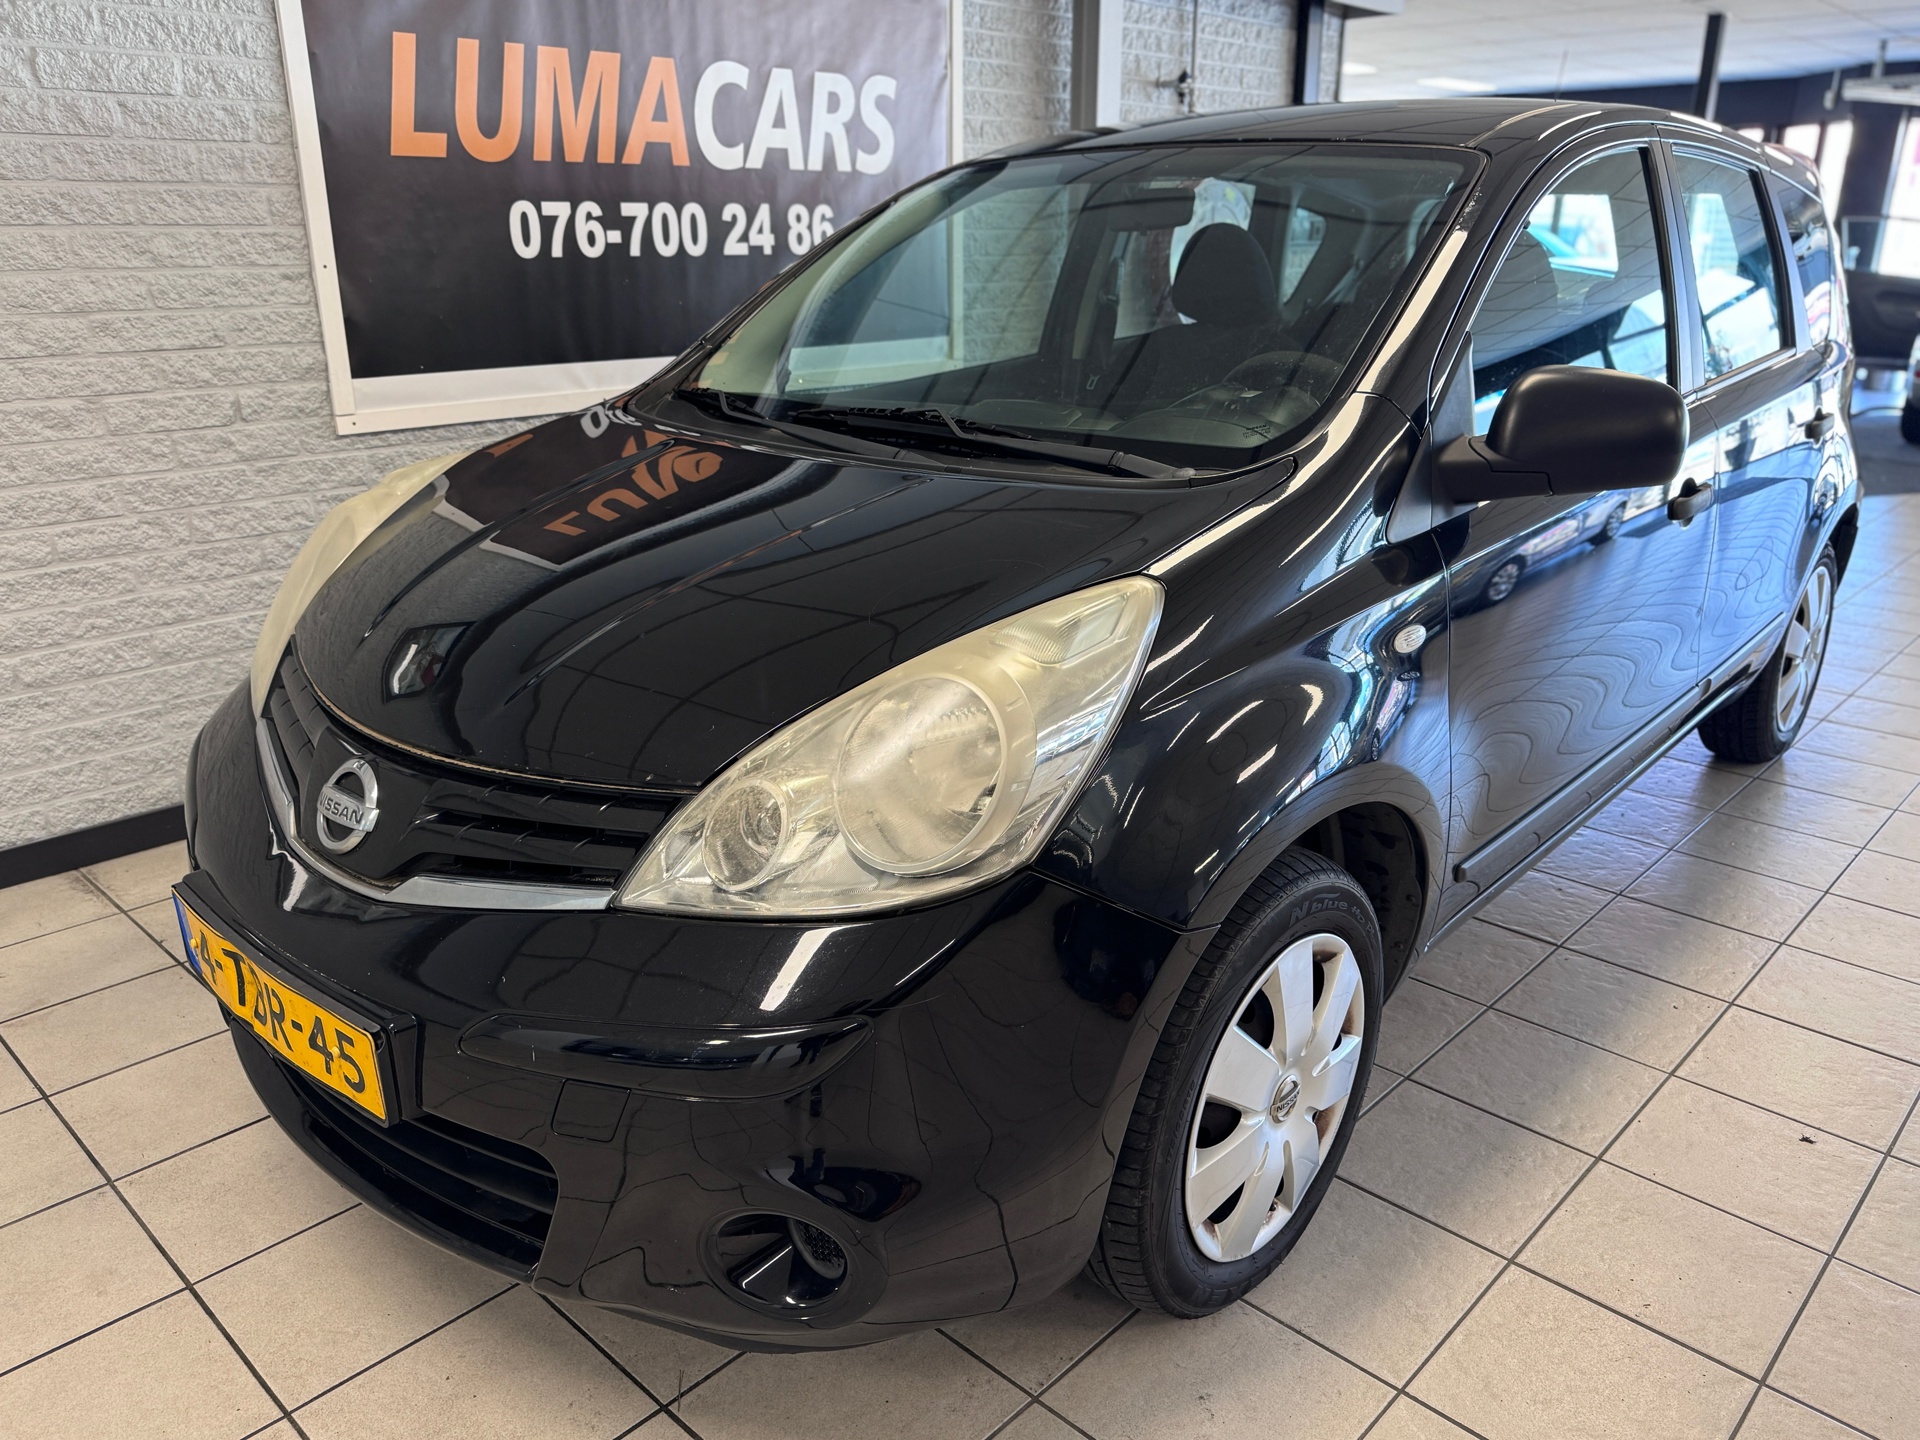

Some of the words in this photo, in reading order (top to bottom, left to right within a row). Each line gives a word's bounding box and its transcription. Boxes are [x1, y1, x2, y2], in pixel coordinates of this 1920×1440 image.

[390, 31, 898, 175] LUMACARS
[508, 200, 708, 259] 076-700
[721, 203, 775, 256] 24
[787, 204, 835, 256] 86
[320, 793, 364, 824] NISSAN
